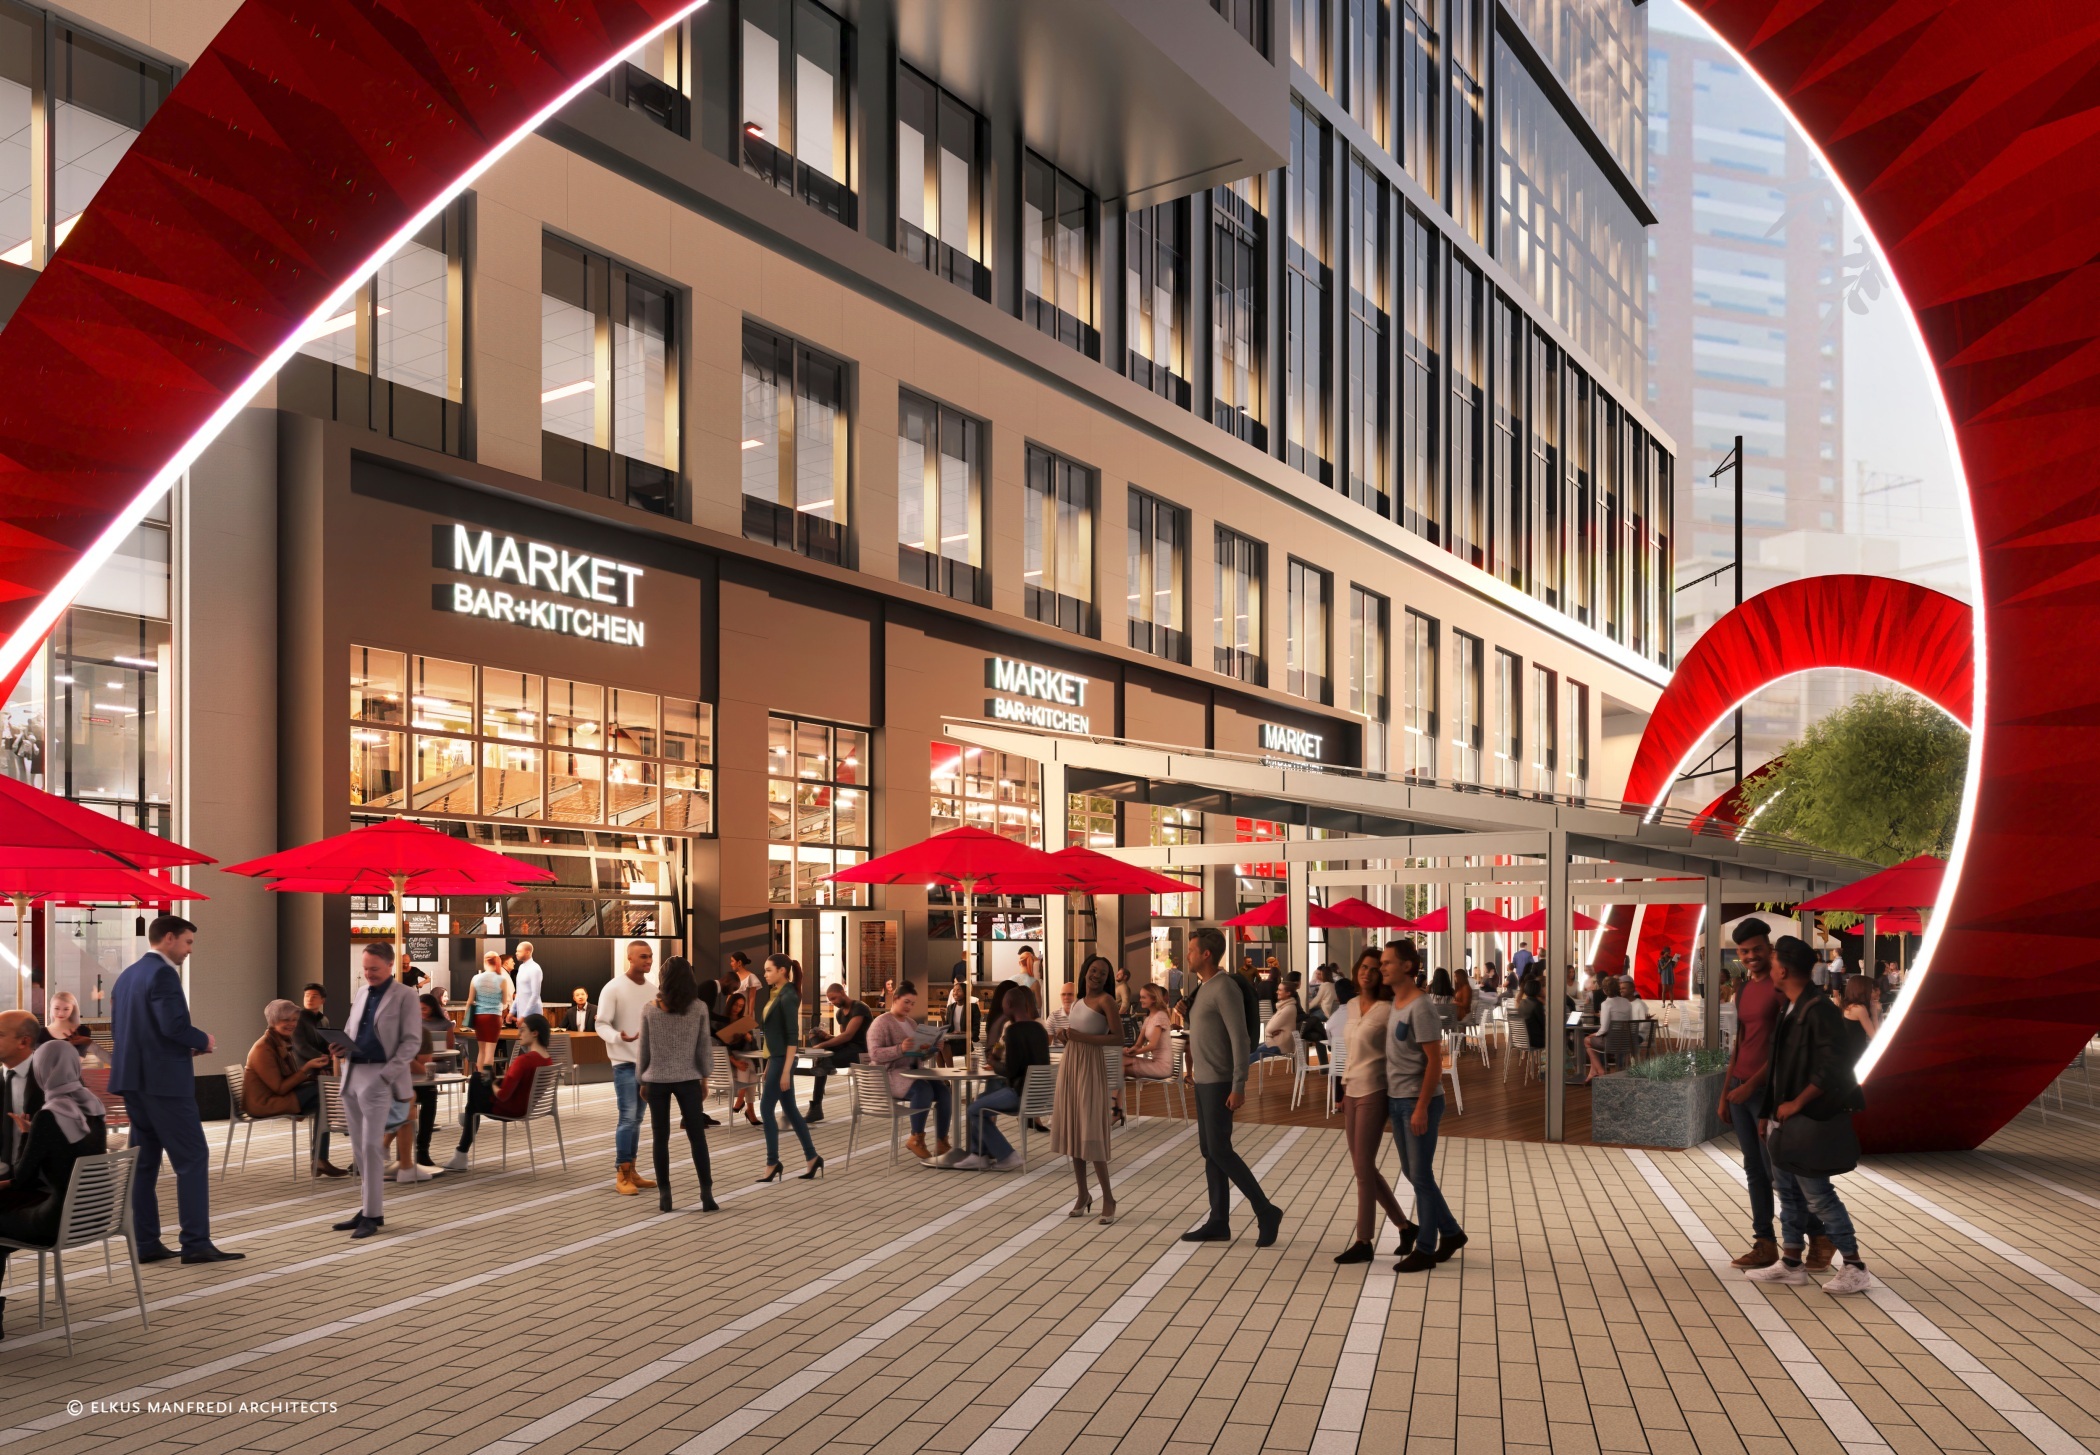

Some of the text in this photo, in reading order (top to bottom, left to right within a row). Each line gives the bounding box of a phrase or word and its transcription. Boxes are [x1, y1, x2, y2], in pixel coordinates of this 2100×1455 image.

[453, 523, 644, 608] MARKET
[453, 582, 645, 647] BAR+KITCHEN
[994, 656, 1089, 707] MARKET
[994, 697, 1089, 735] BAR+KITCHEN
[1265, 723, 1323, 760] MARKET
